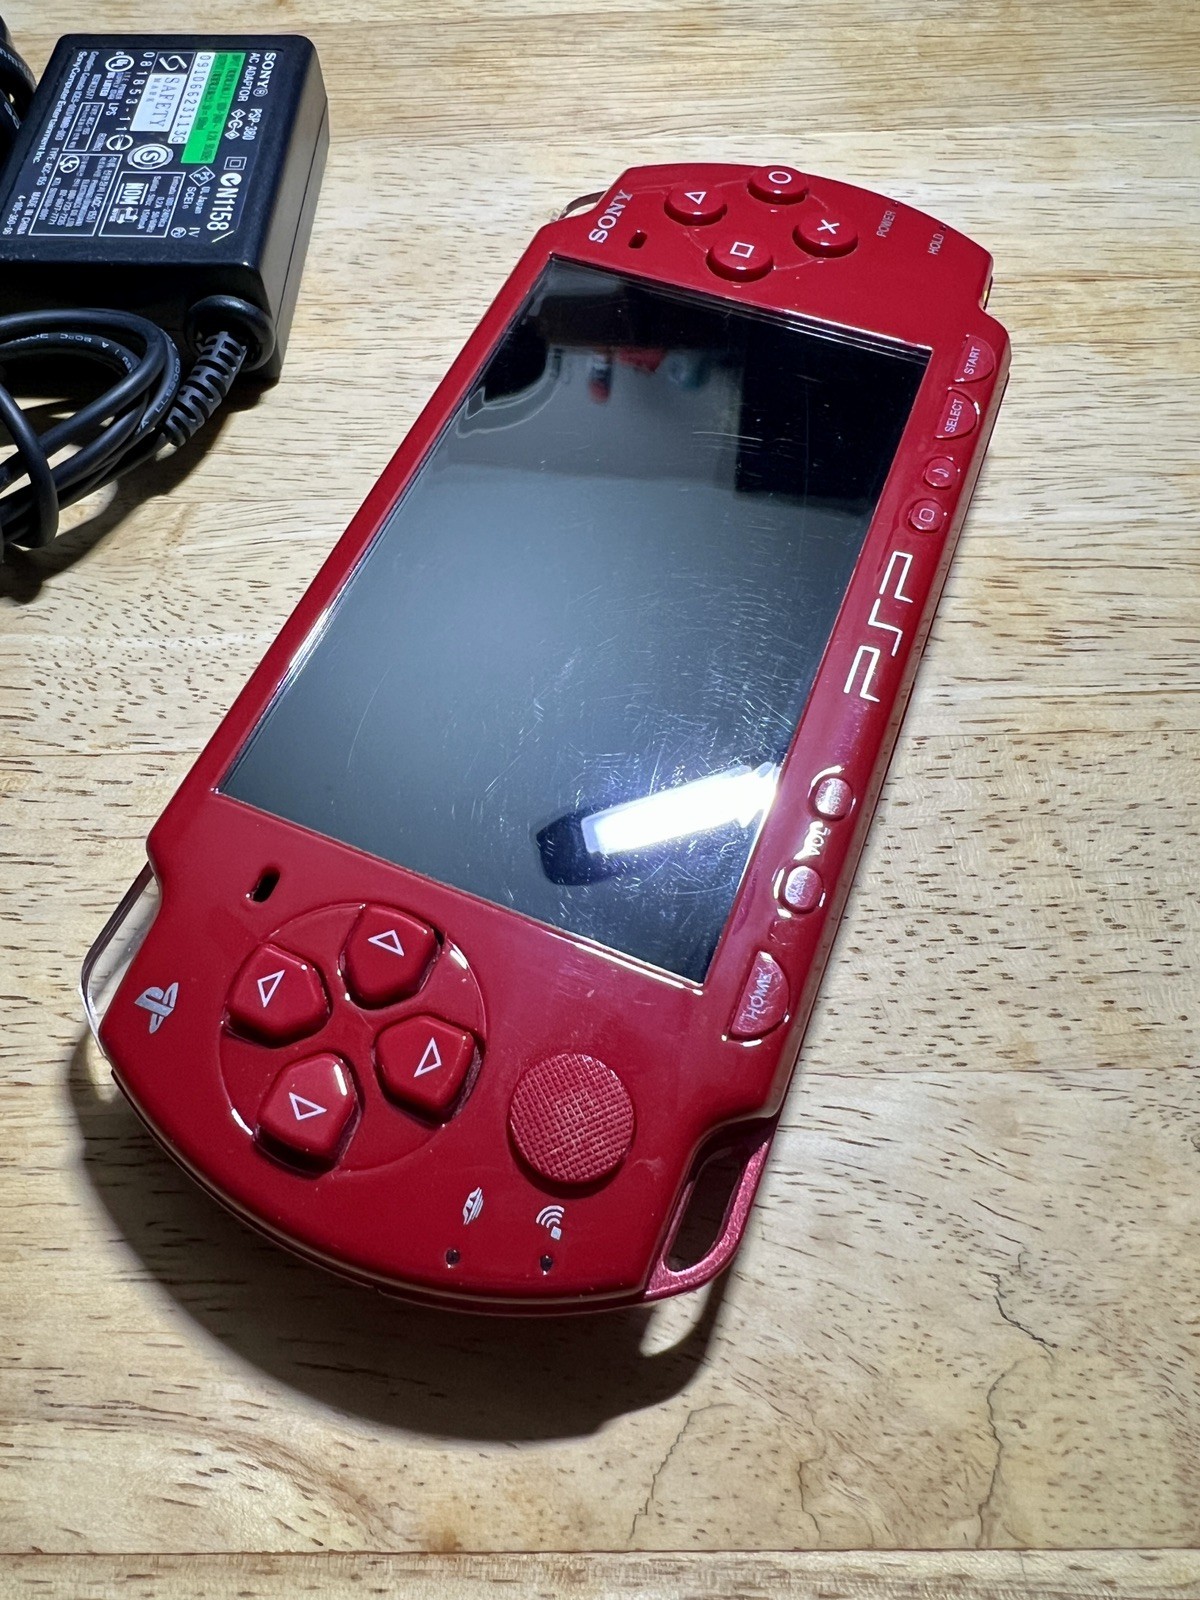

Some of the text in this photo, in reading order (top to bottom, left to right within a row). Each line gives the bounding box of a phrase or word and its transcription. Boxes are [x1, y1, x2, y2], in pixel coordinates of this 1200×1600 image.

[237, 52, 260, 101] AC ADAPTOR
[105, 102, 119, 116] LPS
[149, 77, 180, 127] SAFETY
[119, 182, 144, 204] NOM
[589, 190, 632, 243] SONY
[876, 210, 896, 238] POWER
[928, 233, 944, 255] HOLD
[964, 346, 981, 374] START
[945, 399, 964, 433] SELECT
[844, 551, 913, 702] PSP
